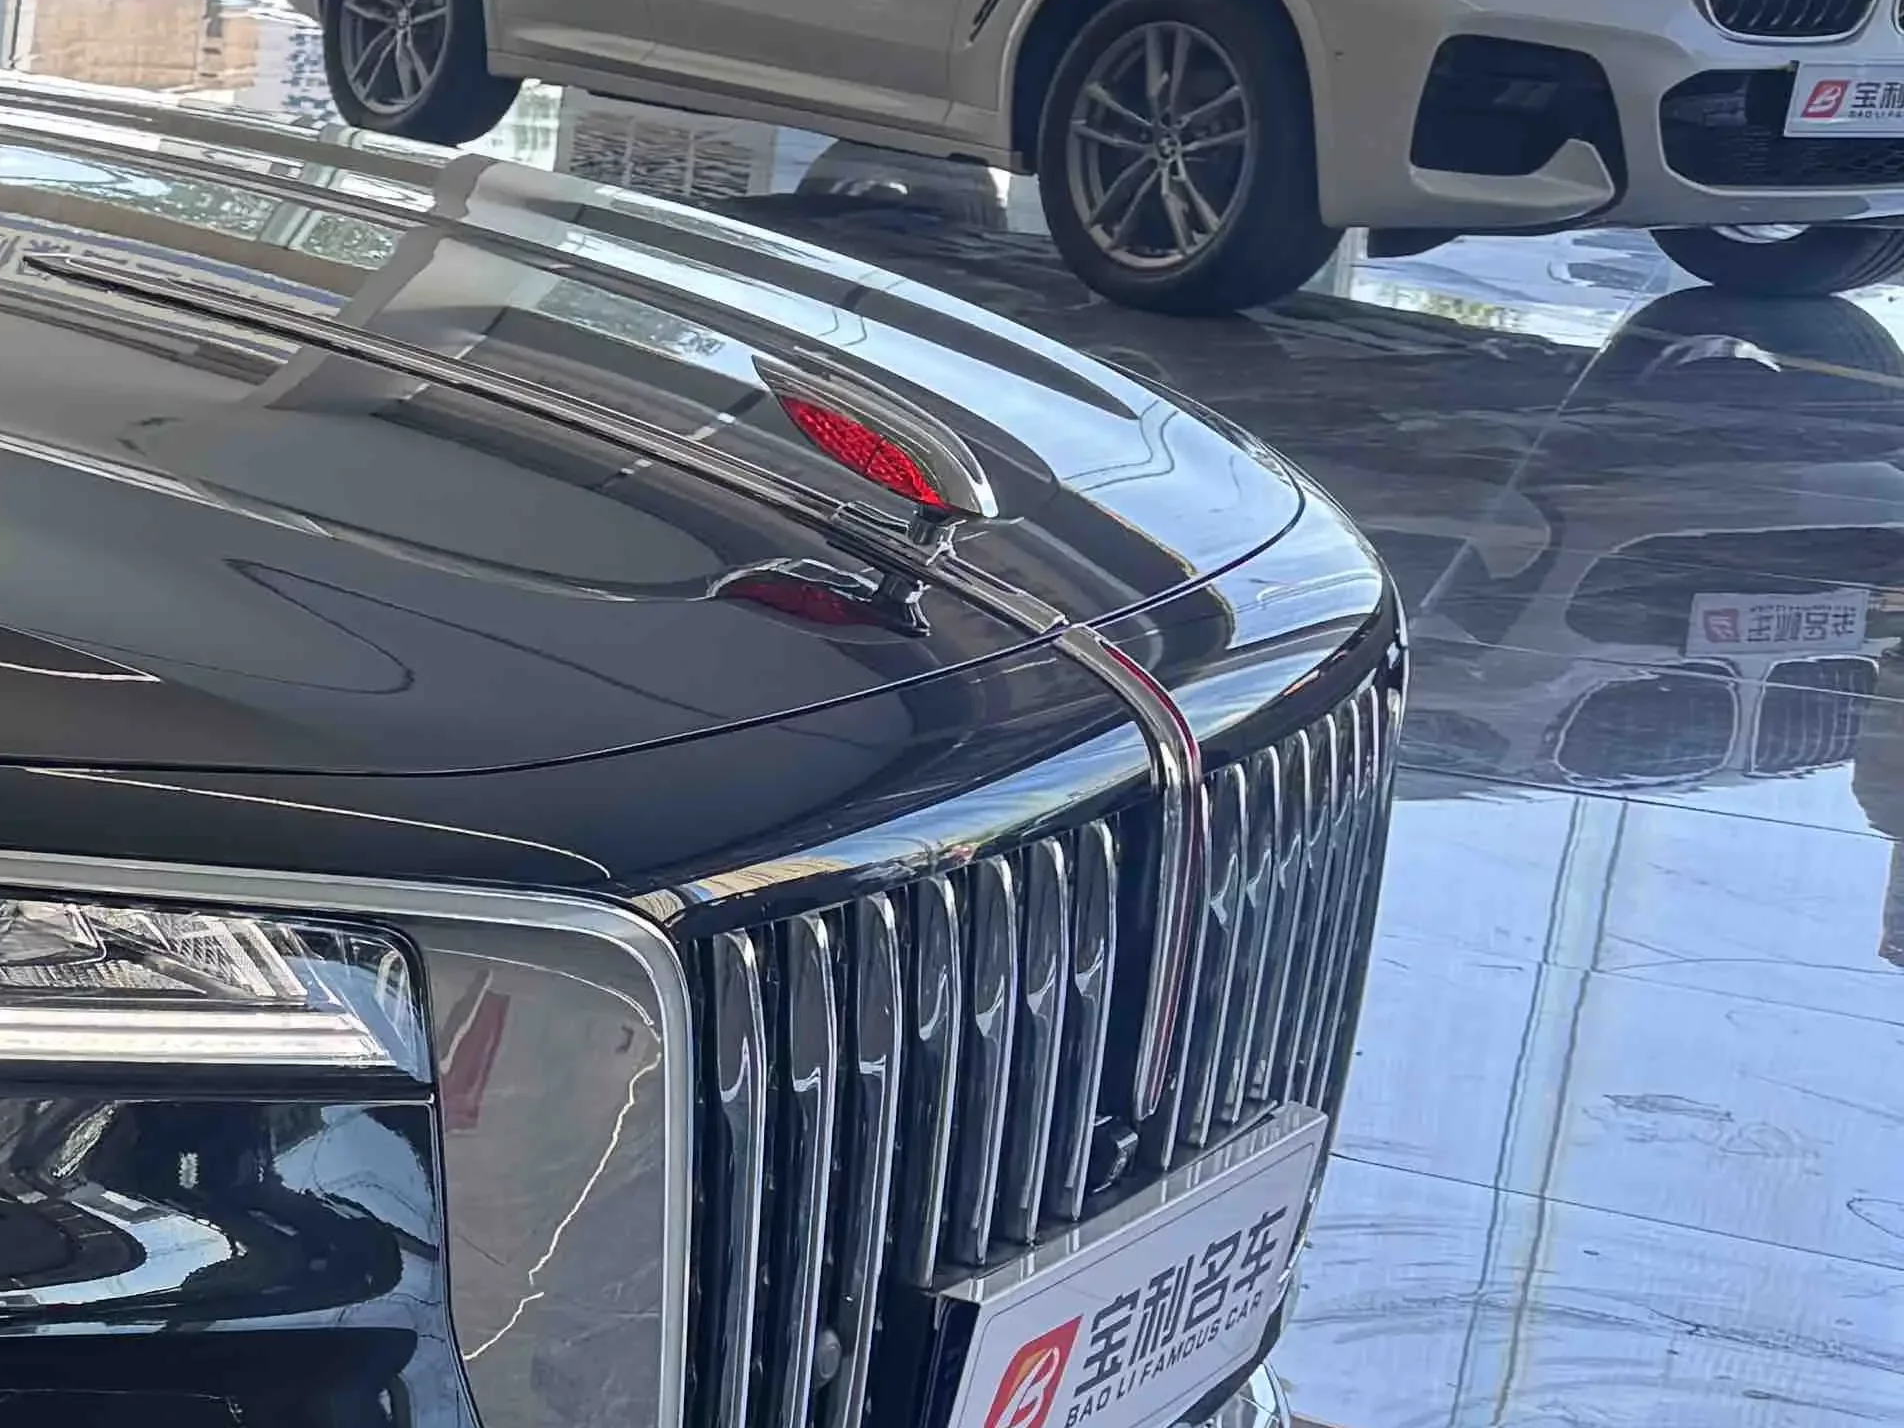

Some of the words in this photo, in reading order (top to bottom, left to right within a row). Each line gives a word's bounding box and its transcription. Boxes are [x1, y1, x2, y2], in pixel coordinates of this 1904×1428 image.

[1074, 1205, 1289, 1399] 宝利名车
[1117, 1369, 1137, 1400] LI
[1140, 1317, 1222, 1387] FAMOUS
[1225, 1290, 1263, 1331] CAR
